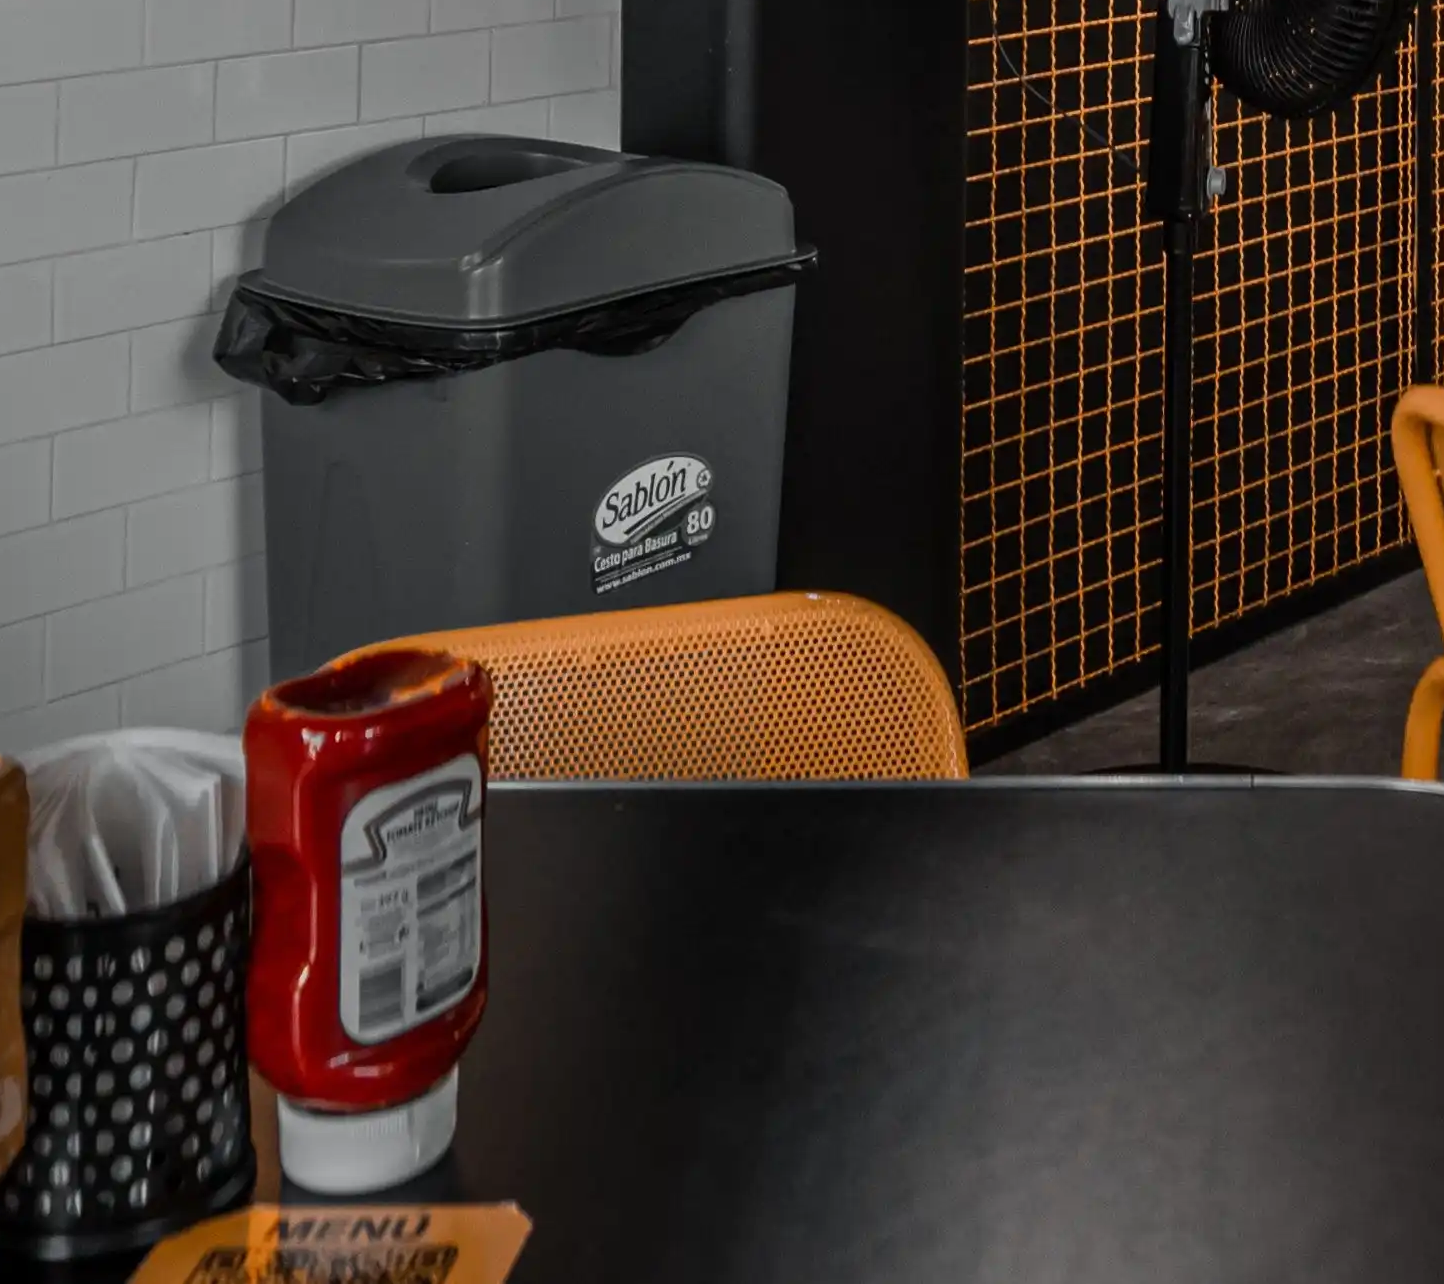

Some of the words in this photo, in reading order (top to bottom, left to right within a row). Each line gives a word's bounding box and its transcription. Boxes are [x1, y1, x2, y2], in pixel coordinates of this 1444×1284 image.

[602, 460, 686, 530] Sablón
[687, 505, 713, 534] 80
[594, 553, 621, 573] Cesto
[621, 544, 644, 567] para
[644, 531, 677, 553] Basura
[264, 1213, 433, 1242] MENU
